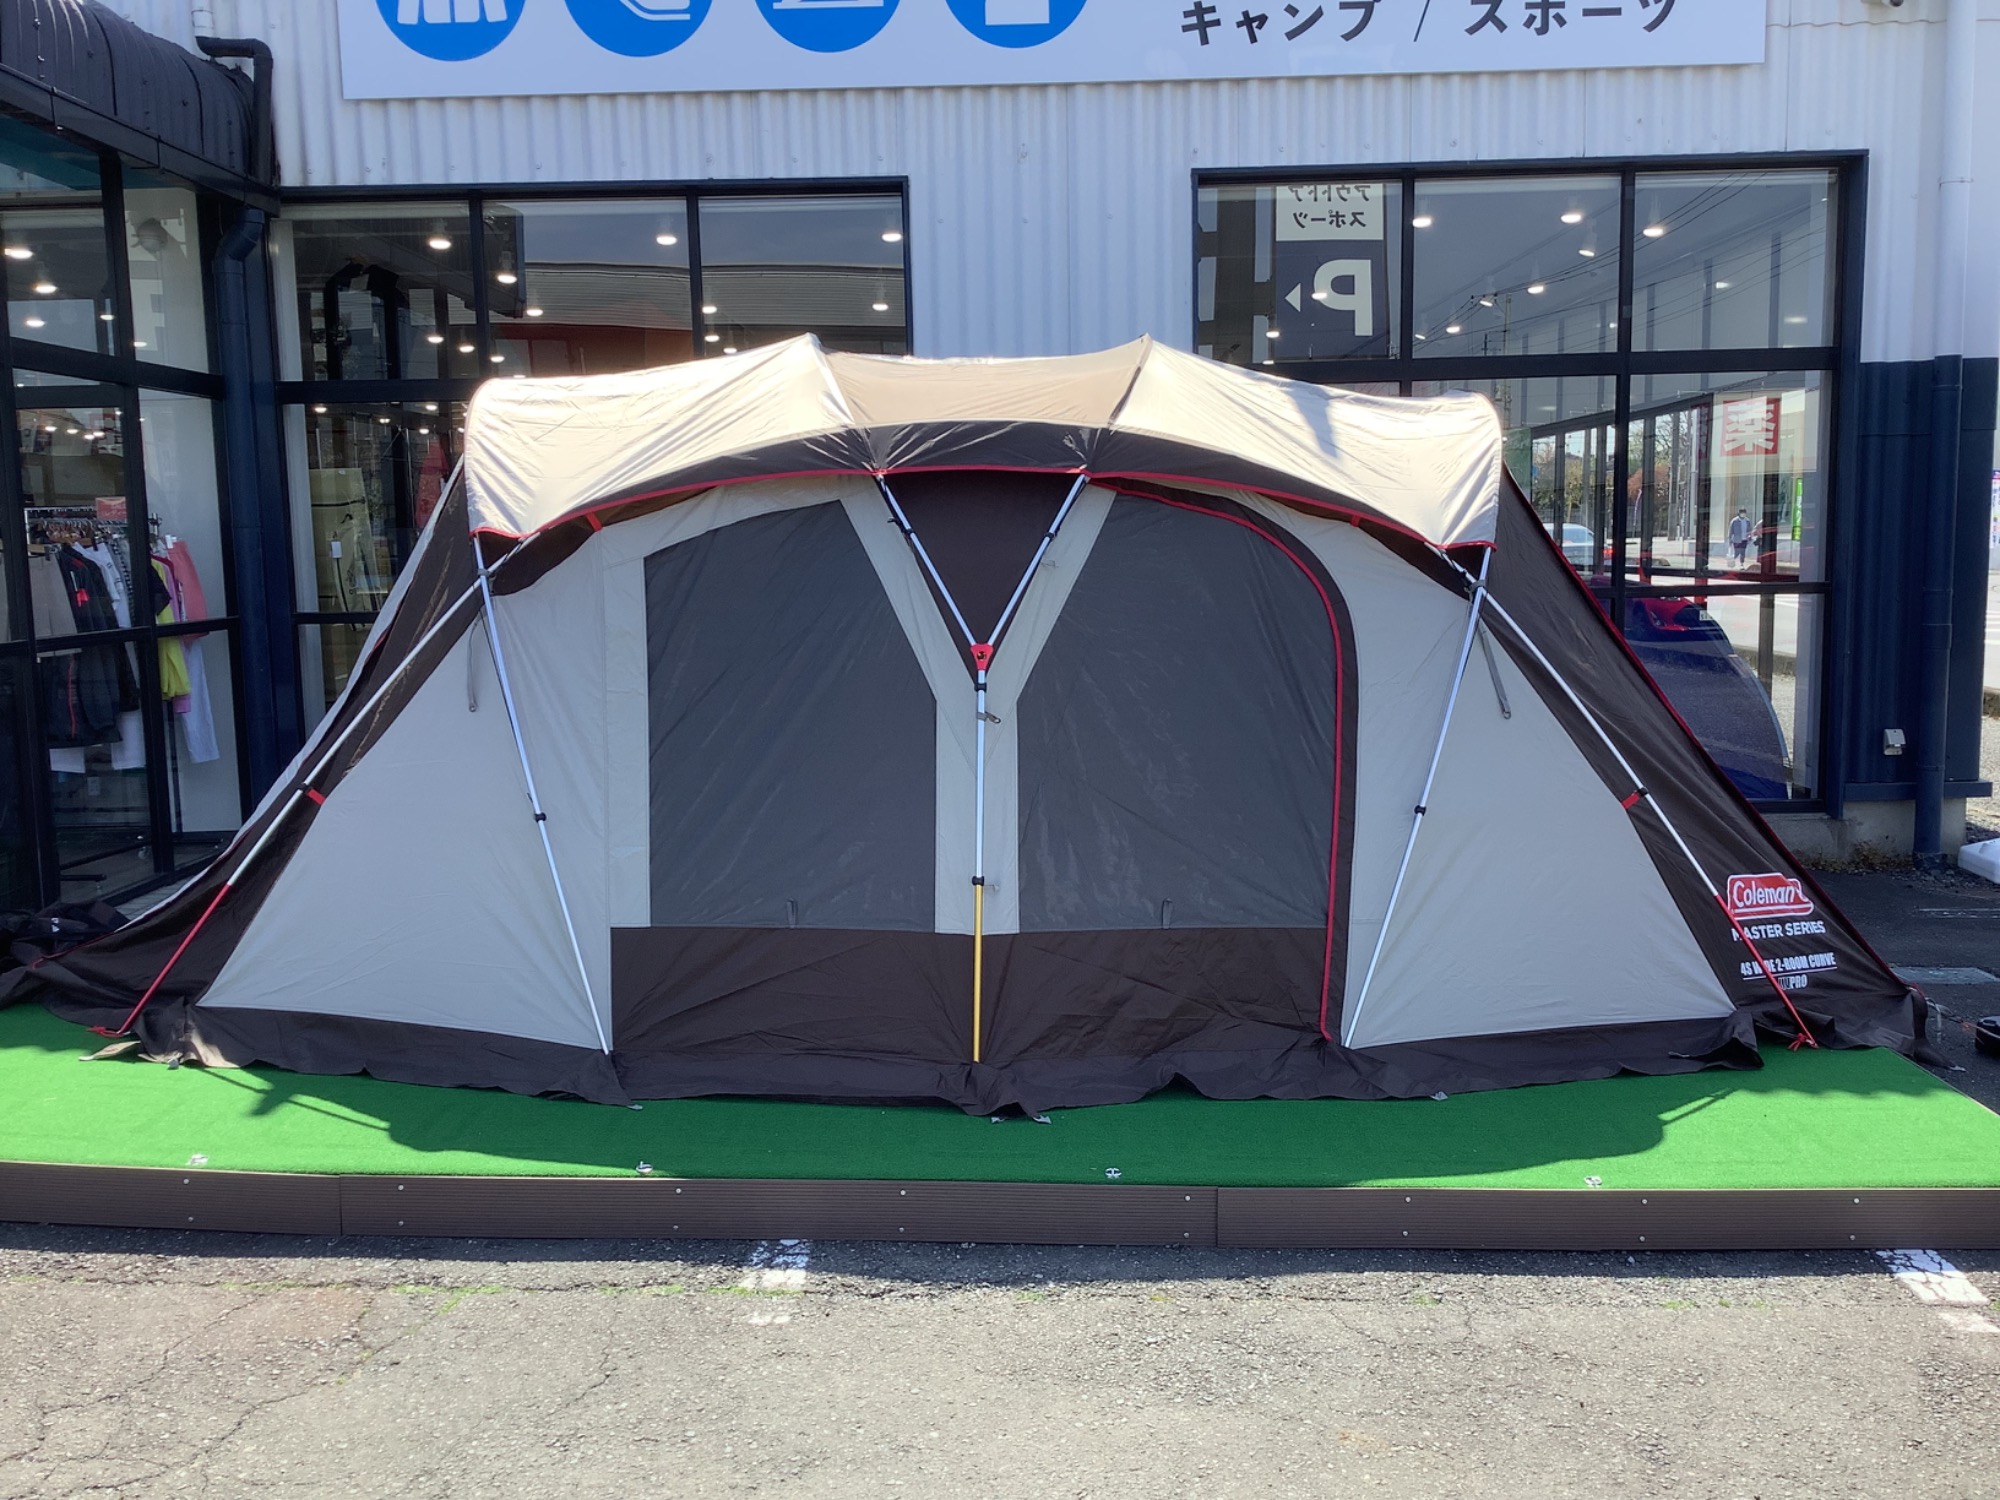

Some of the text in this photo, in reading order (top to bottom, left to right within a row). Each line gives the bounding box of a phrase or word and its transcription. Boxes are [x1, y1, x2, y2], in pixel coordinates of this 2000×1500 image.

[1733, 880, 1796, 907] Coleman
[1784, 920, 1826, 936] SERIES
[1775, 955, 1809, 972] 2-ROOM
[1808, 952, 1837, 968] CURVE
